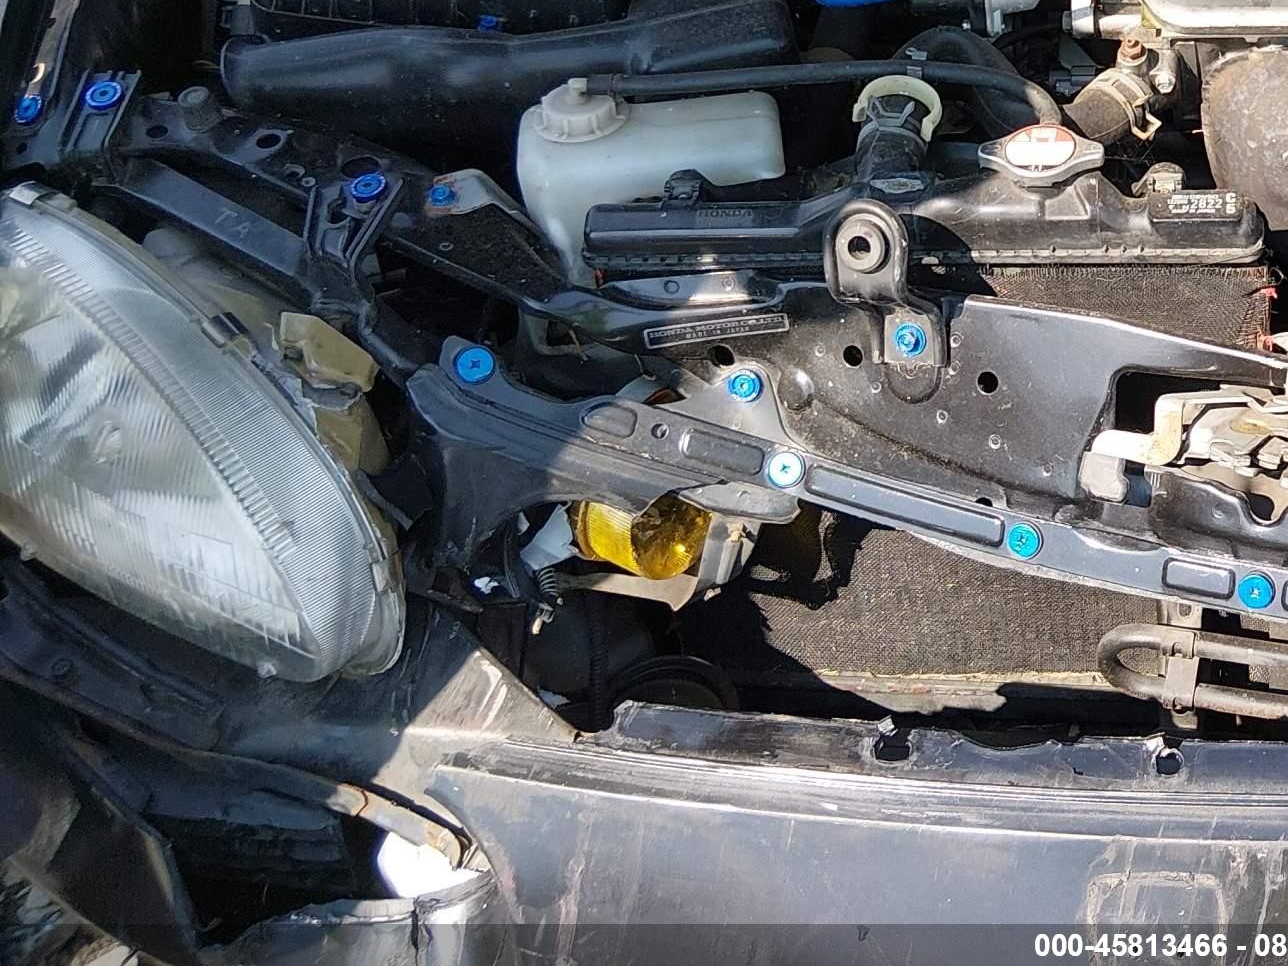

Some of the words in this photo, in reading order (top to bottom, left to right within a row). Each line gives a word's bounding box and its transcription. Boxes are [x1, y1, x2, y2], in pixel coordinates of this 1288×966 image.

[1225, 192, 1236, 203] C
[1190, 198, 1222, 209] 2822
[697, 208, 753, 218] HONDA
[649, 328, 695, 339] HONDA
[694, 321, 740, 331] MOTOR
[725, 326, 750, 334] JAPAN
